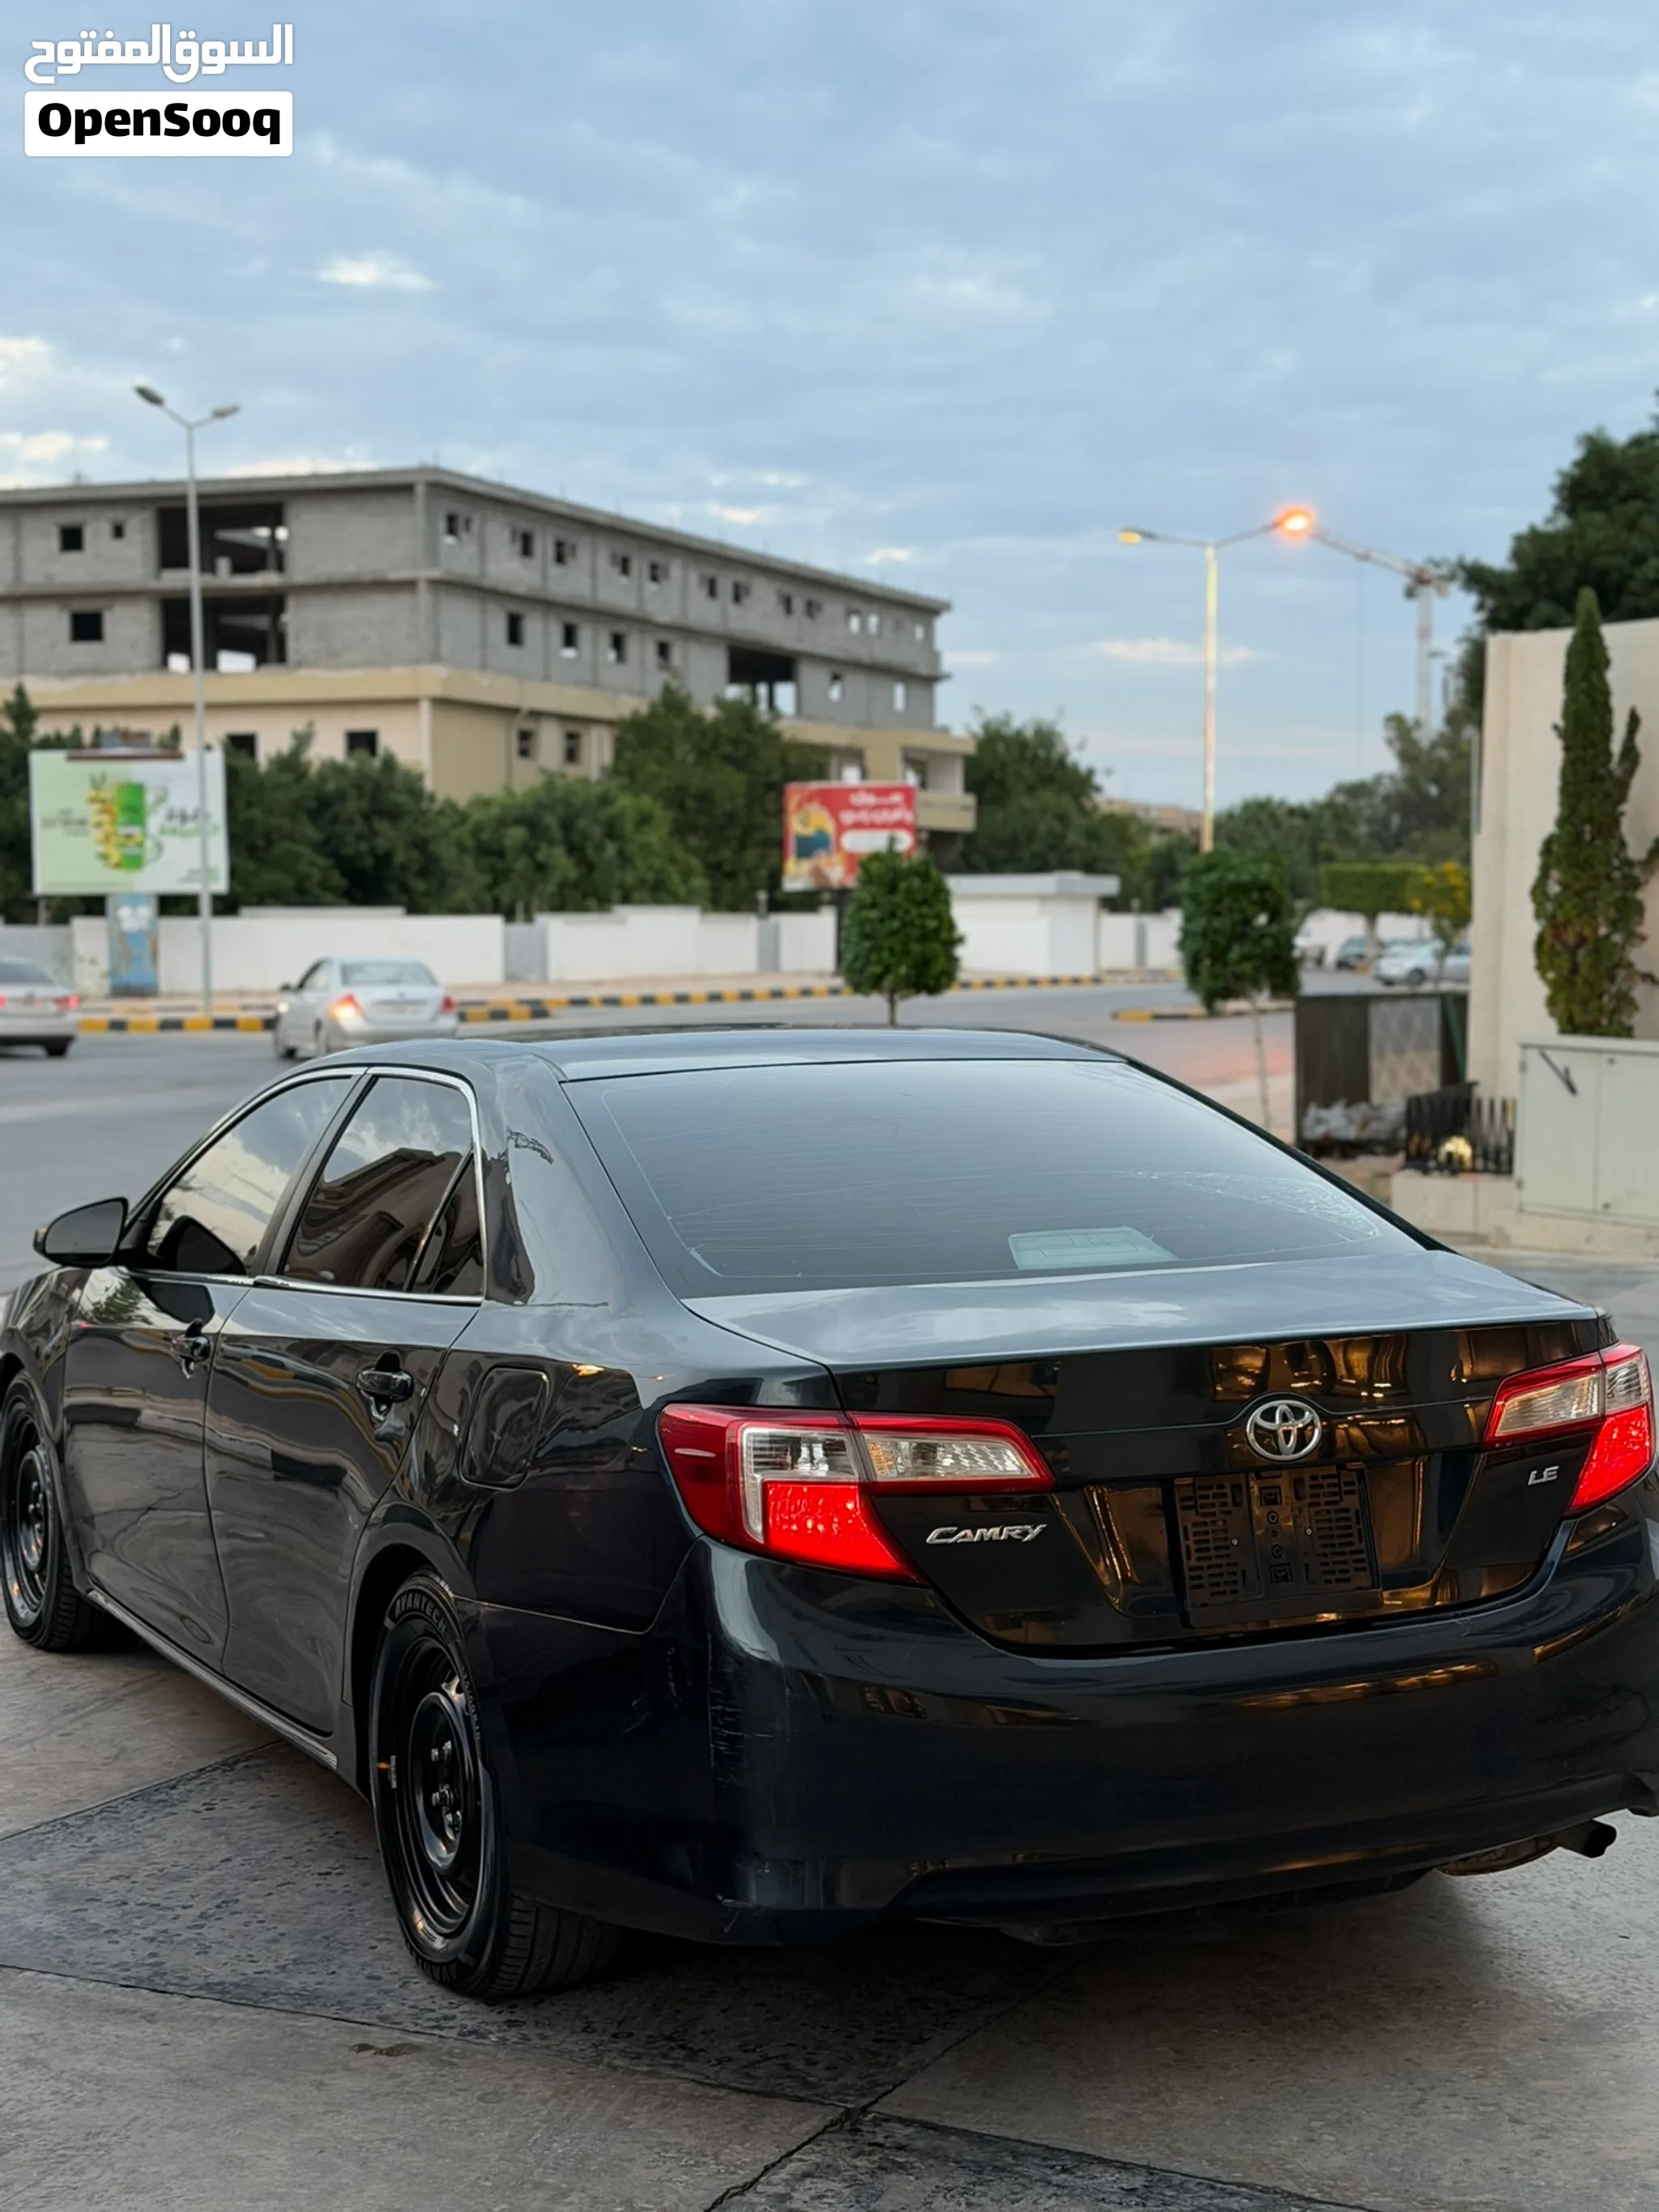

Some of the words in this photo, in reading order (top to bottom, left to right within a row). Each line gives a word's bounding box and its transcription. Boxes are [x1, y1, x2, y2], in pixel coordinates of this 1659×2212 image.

[1528, 1465, 1559, 1486] LE
[926, 1524, 1047, 1545] CAMRY
[394, 1592, 447, 1634] AVANTECH
